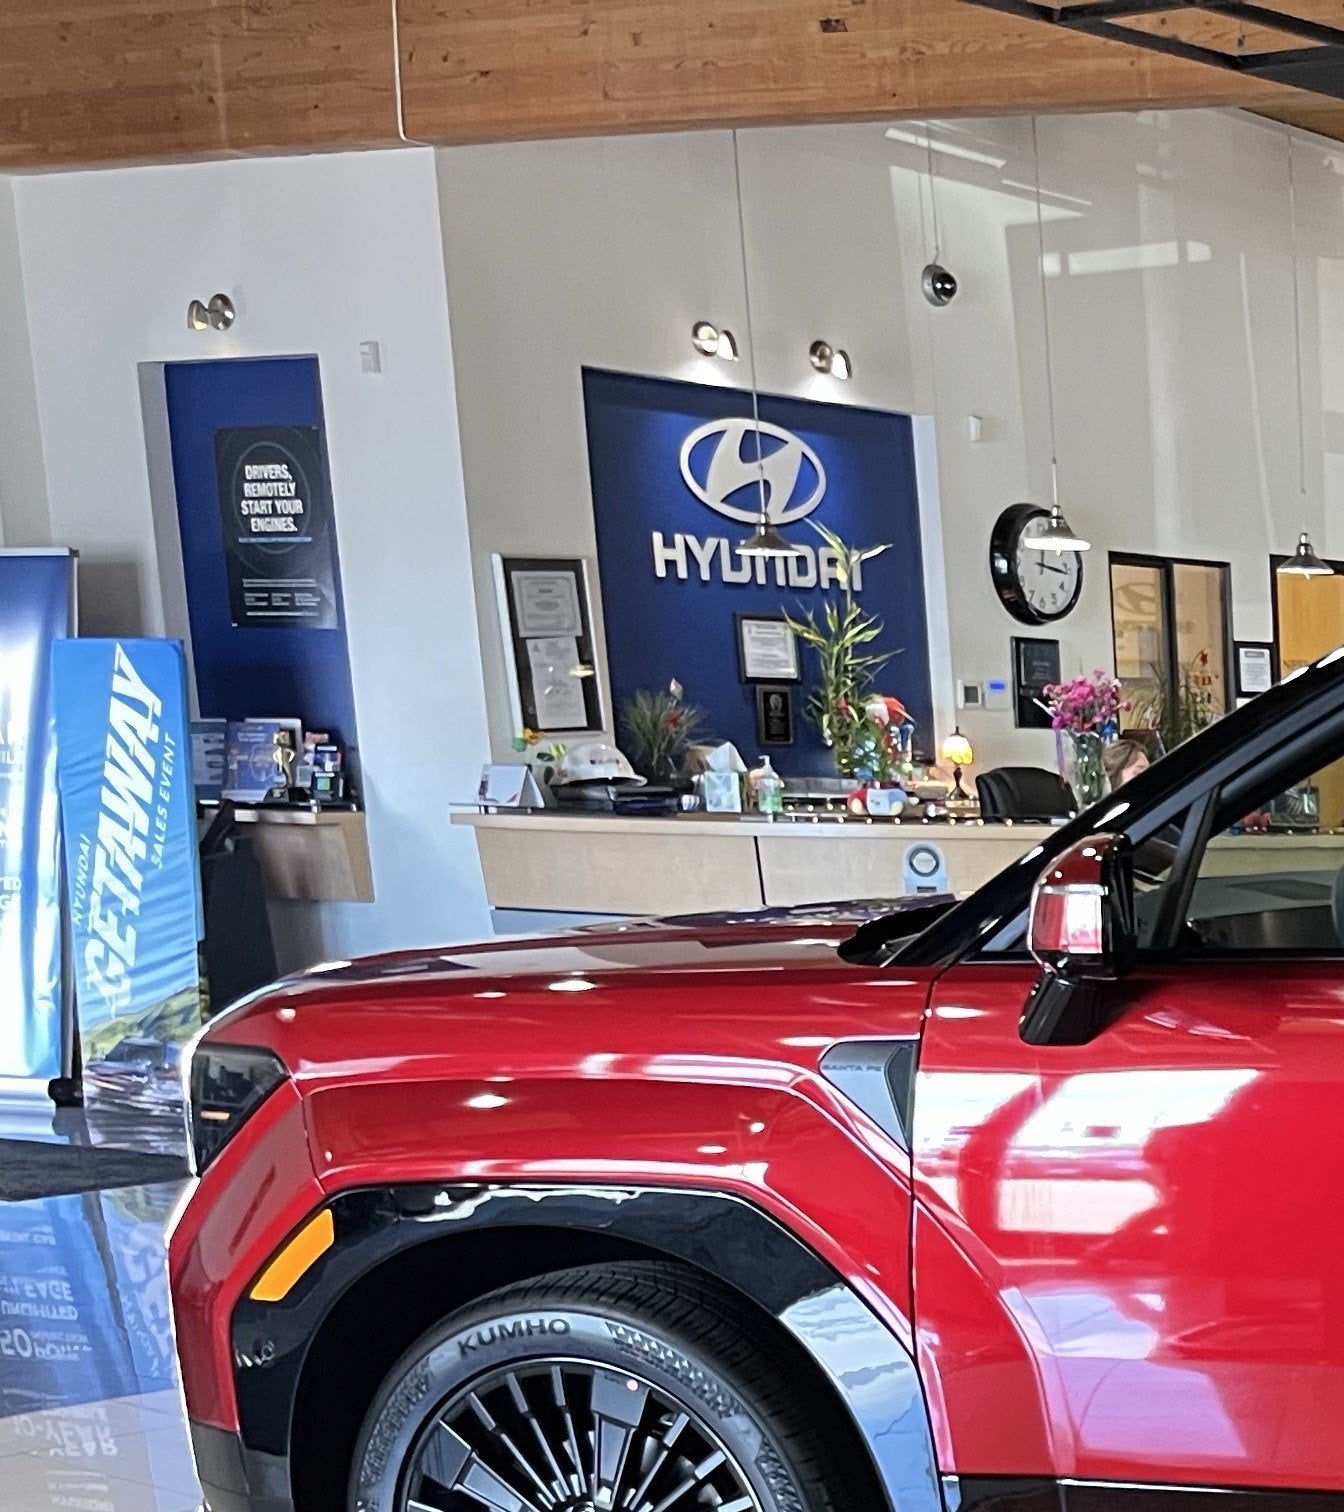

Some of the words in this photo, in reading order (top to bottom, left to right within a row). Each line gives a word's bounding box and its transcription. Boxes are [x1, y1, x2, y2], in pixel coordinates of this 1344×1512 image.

[243, 482, 296, 498] REMOTELY
[244, 464, 293, 481] DRIVERS,
[240, 499, 273, 516] START
[274, 499, 304, 515] YOUR
[250, 516, 298, 532] ENGINES.
[651, 530, 864, 592] HYUNDAI
[158, 733, 177, 803] EVENT
[84, 642, 162, 1019] GETAWAY
[151, 805, 170, 871] SALES
[71, 833, 93, 926] HYUNDAI
[456, 1318, 571, 1360] KUMHO
